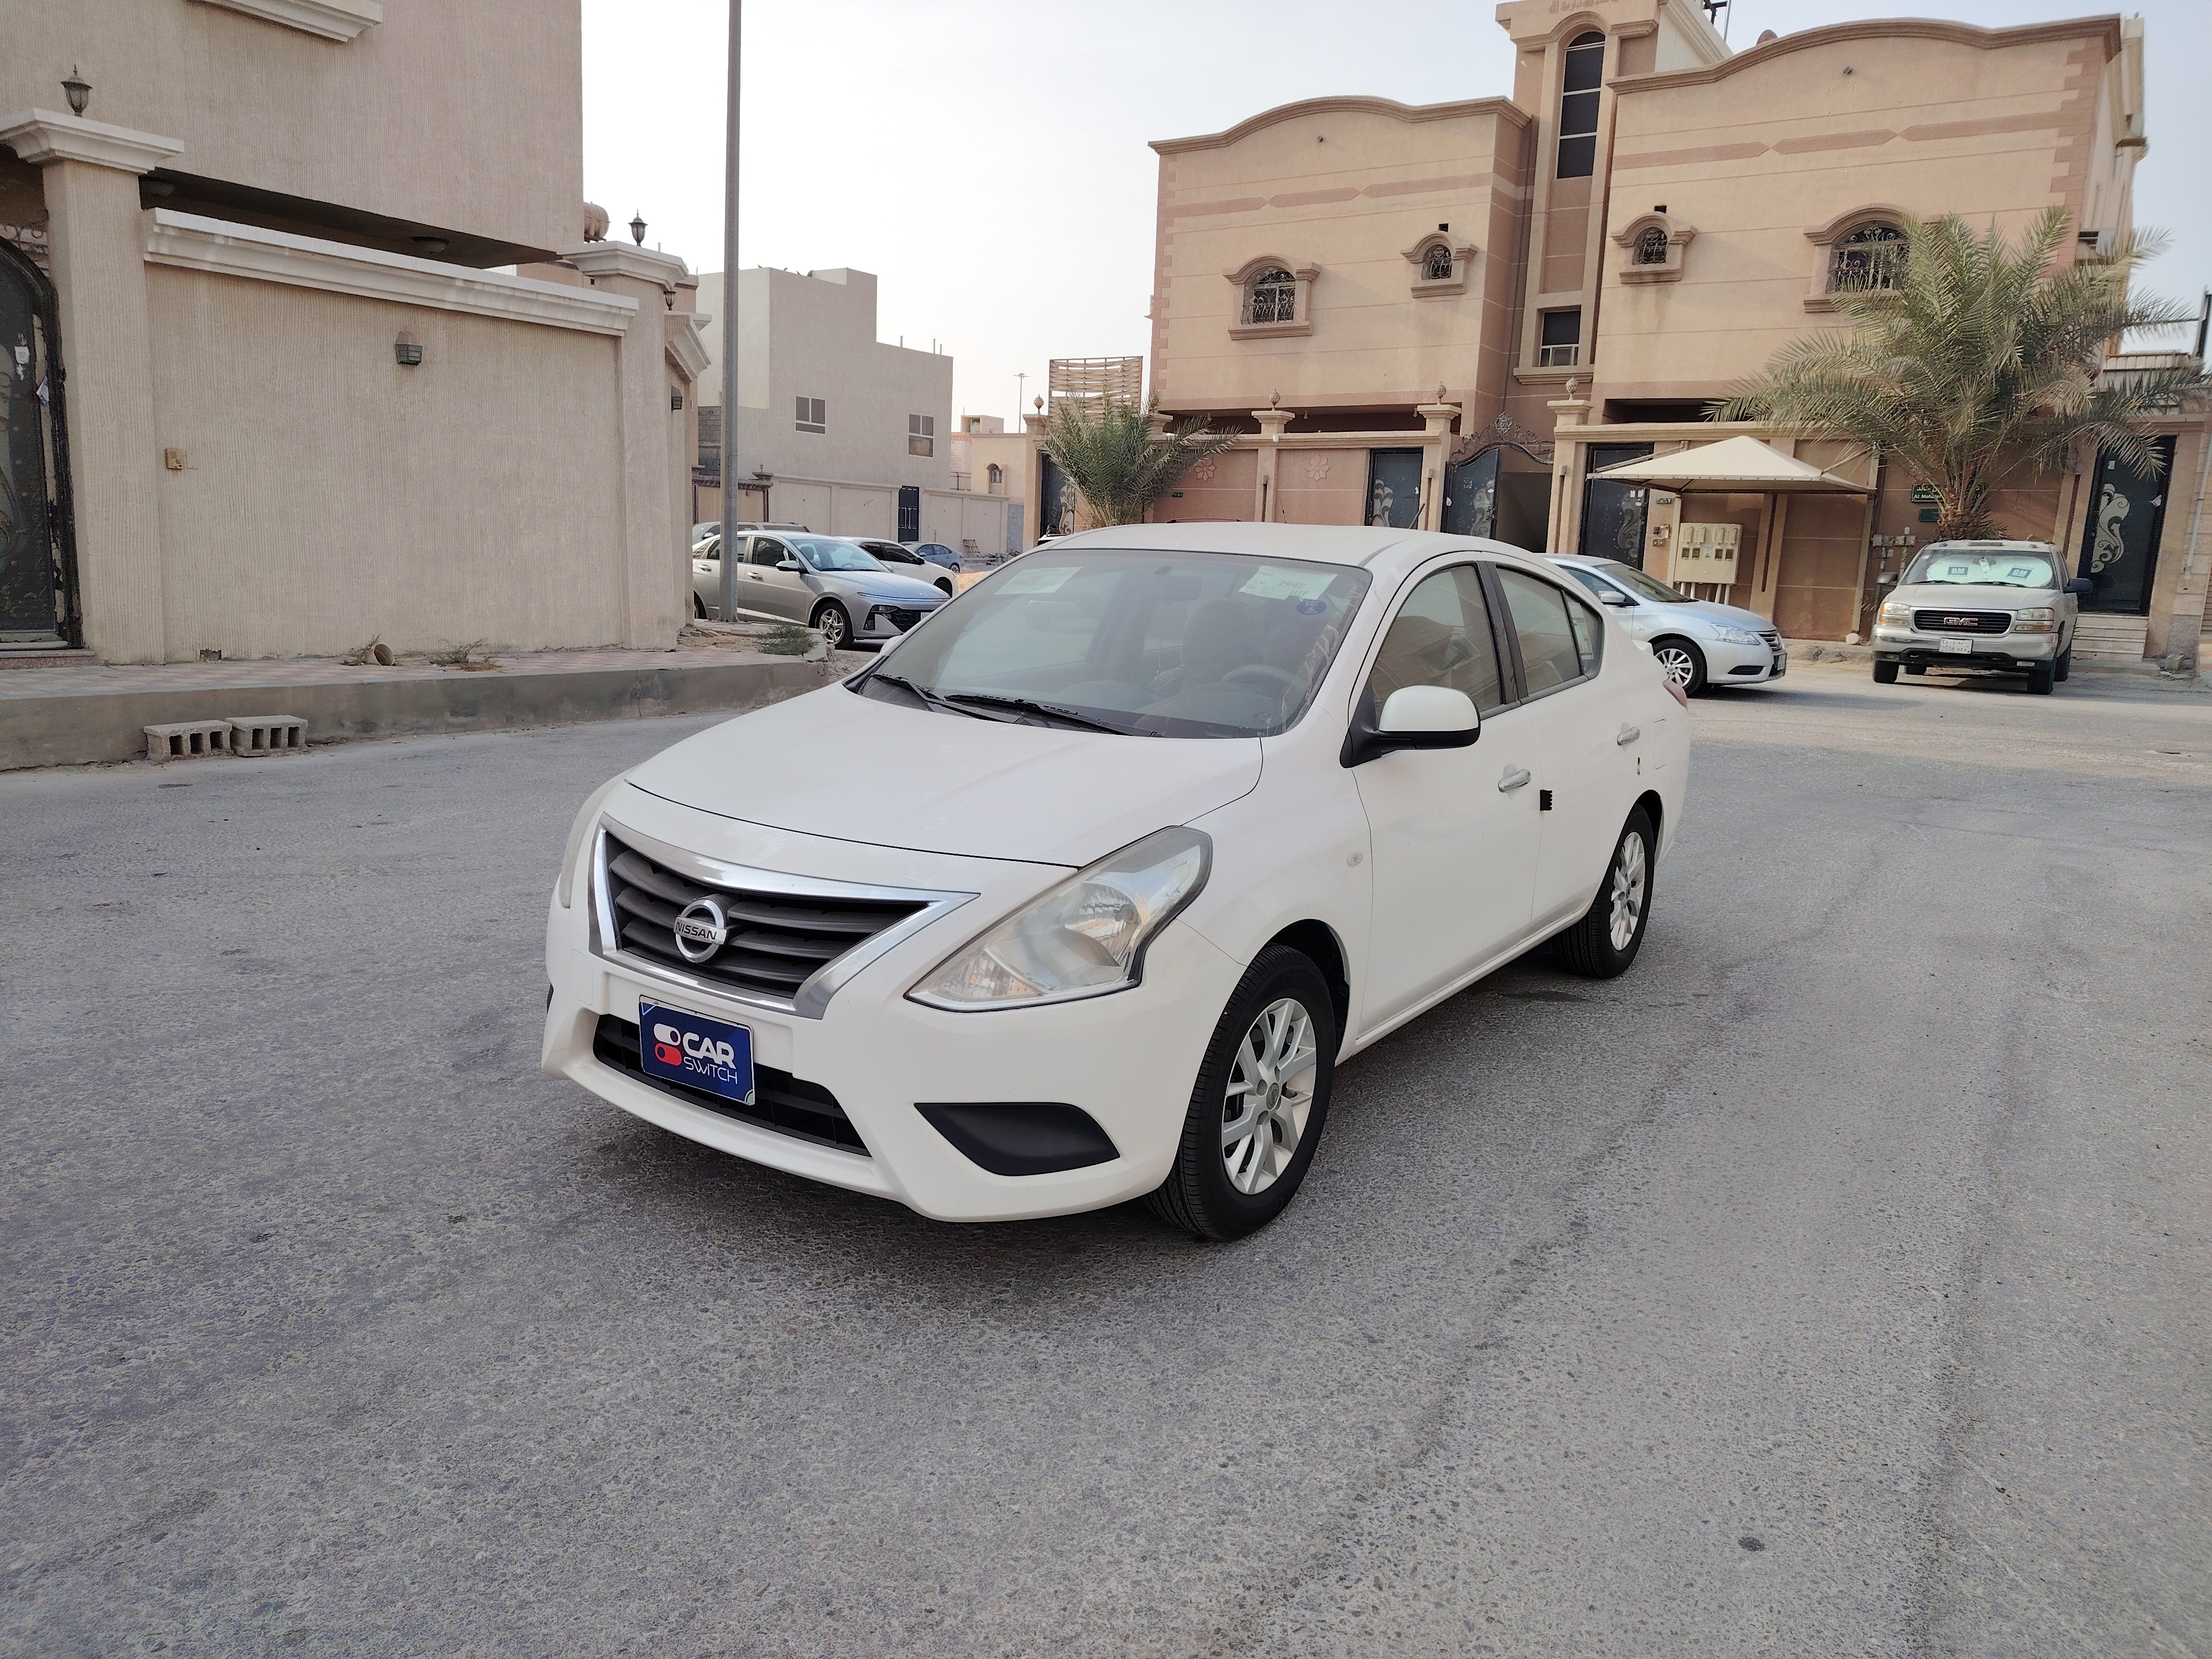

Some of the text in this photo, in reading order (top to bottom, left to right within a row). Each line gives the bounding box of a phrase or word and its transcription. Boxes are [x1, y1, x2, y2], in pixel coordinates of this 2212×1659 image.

[1278, 581, 1306, 589] 2942
[1943, 617, 1979, 625] GMC
[676, 921, 717, 940] NISSAN
[682, 1032, 737, 1070] CAR
[683, 1056, 738, 1085] SWITCH
